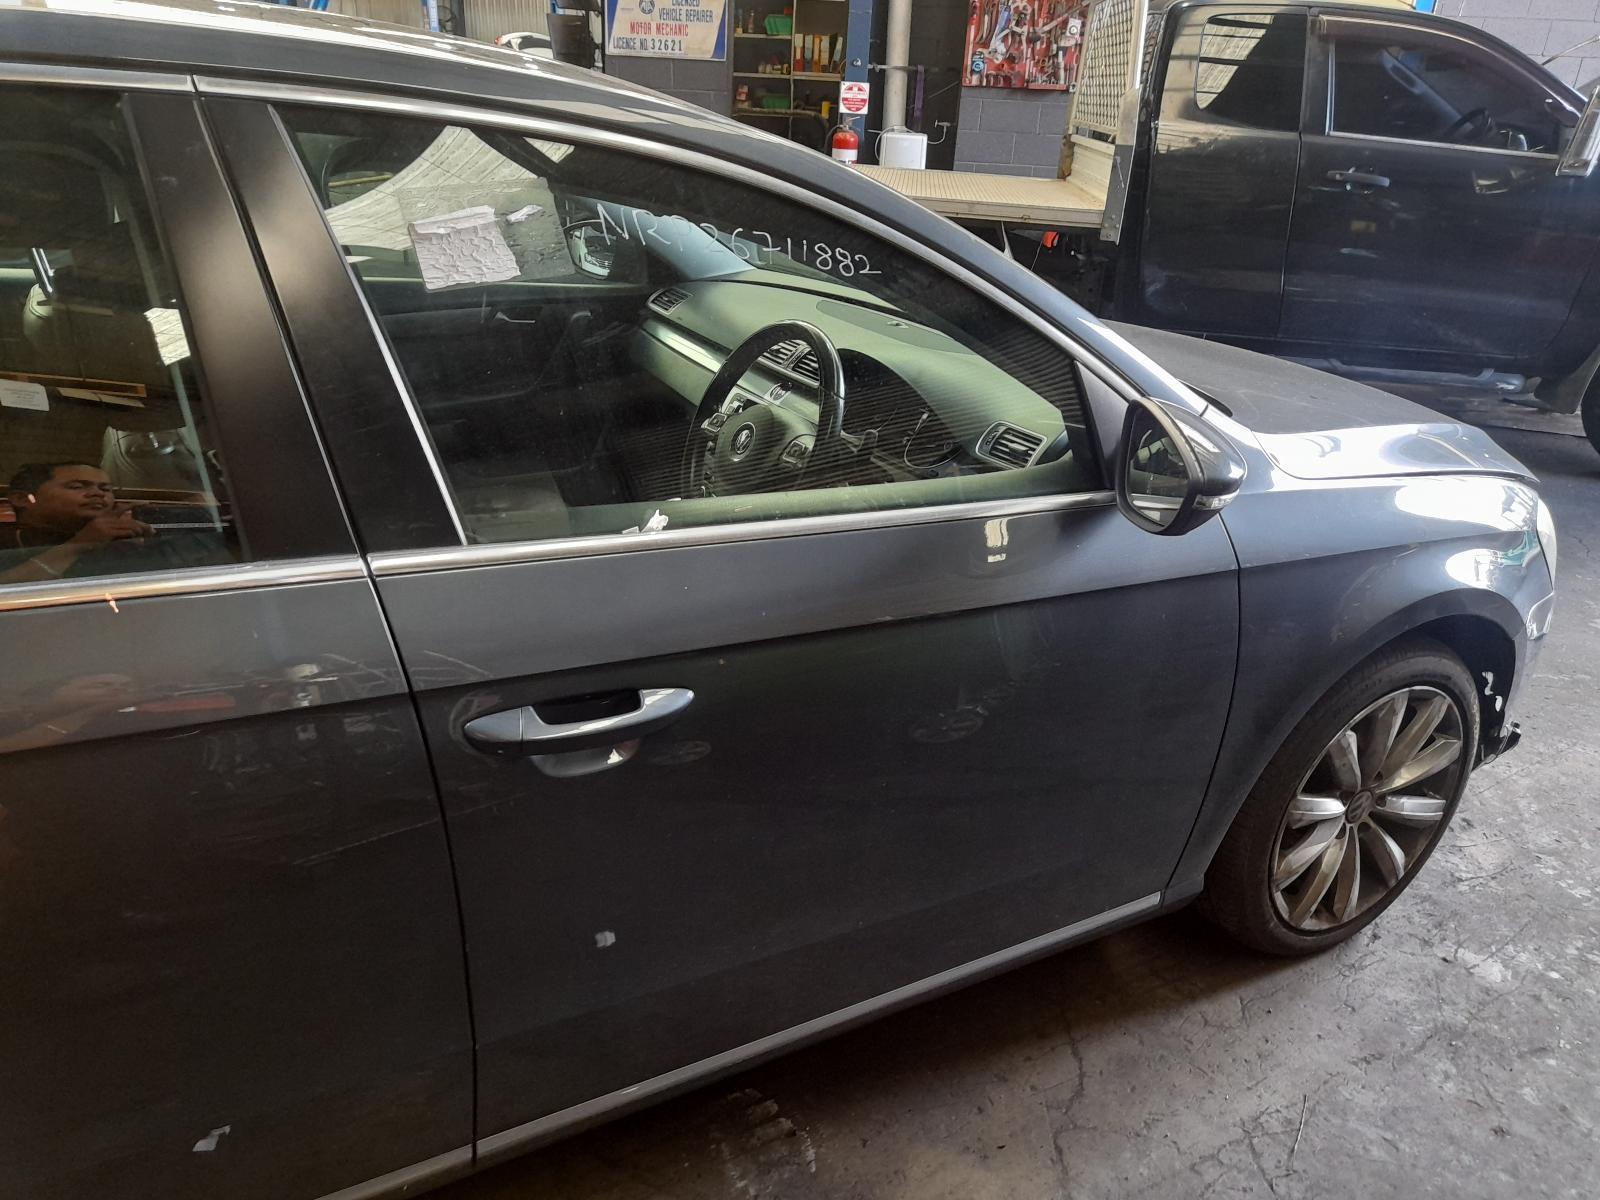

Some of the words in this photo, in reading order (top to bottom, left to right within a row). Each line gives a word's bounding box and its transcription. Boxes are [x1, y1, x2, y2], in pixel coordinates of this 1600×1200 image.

[659, 8, 682, 21] VEHICLE
[685, 10, 714, 23] REPAIRER
[629, 21, 652, 35] MOTOR
[655, 23, 689, 37] MECHANIC
